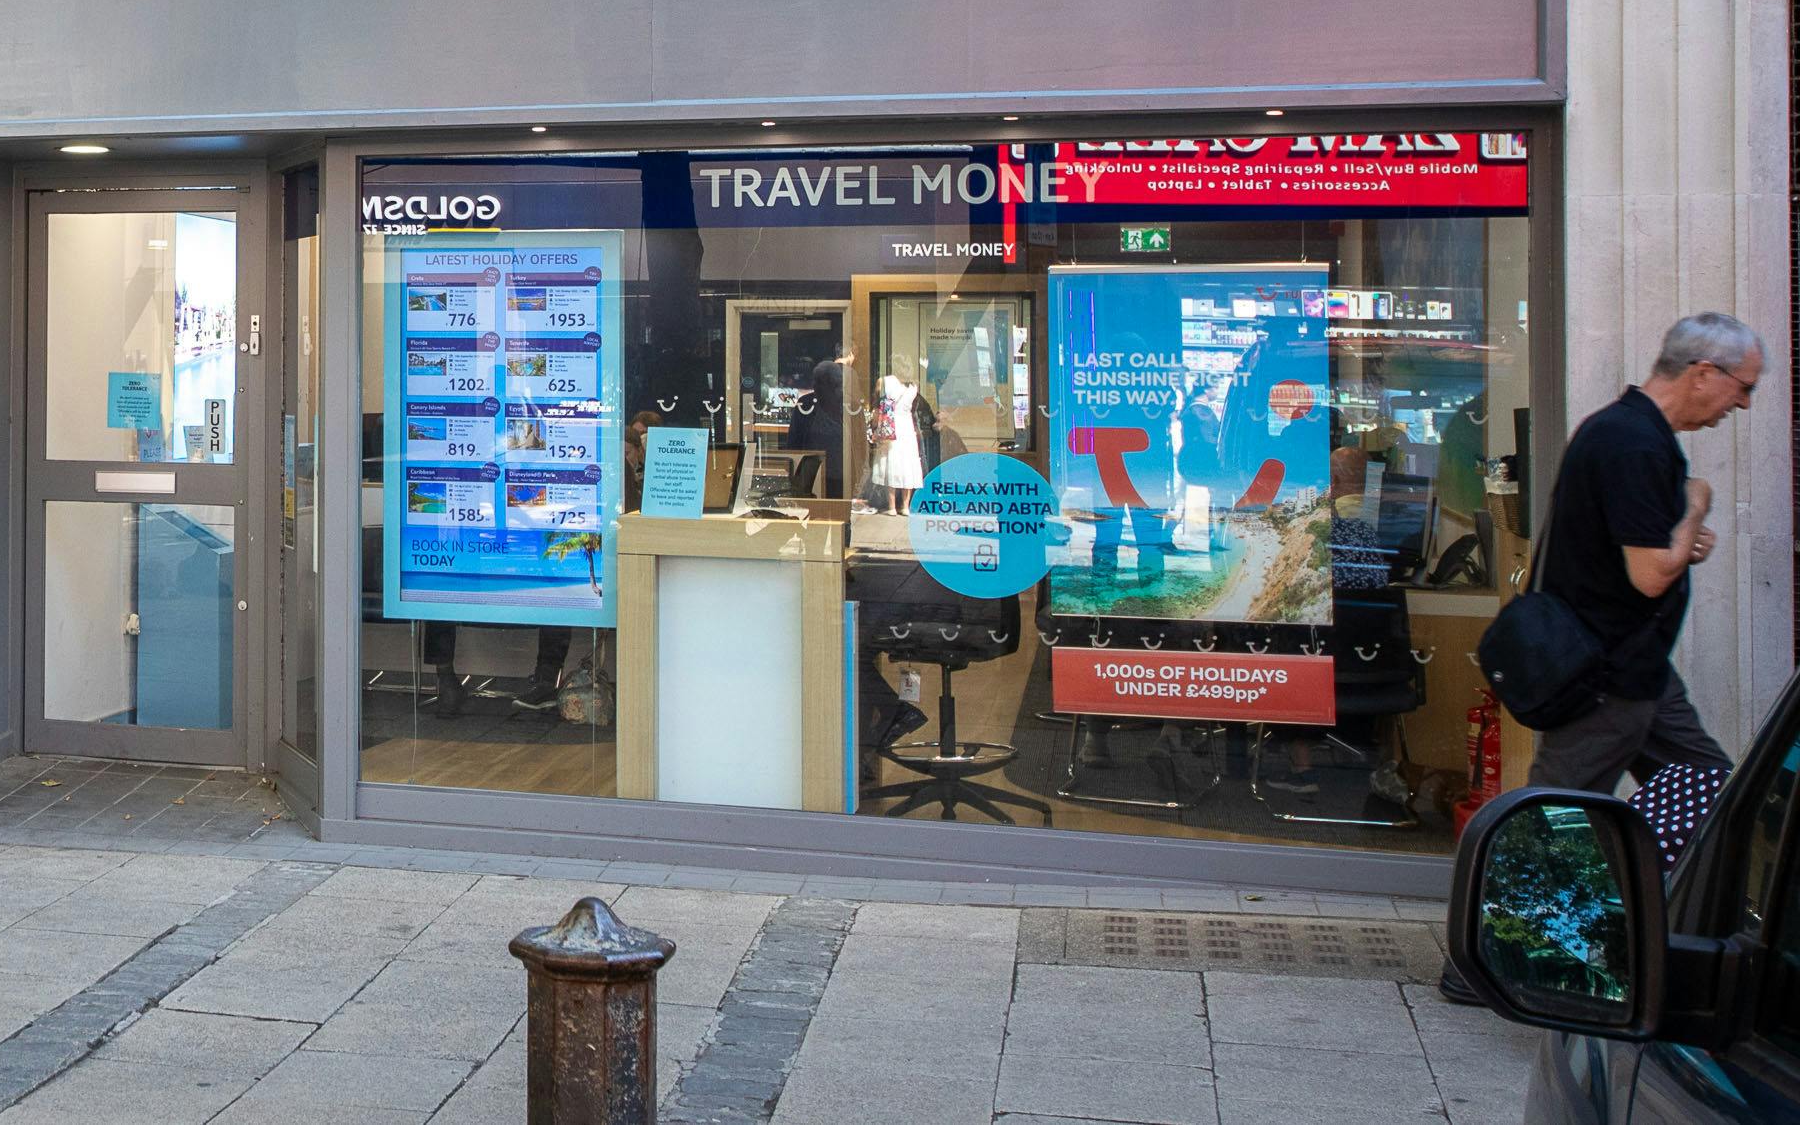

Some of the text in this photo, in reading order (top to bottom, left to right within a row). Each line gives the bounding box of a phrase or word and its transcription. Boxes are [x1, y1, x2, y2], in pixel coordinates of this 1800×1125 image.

[700, 162, 1101, 208] TRAVEL MONEY
[892, 242, 1015, 257] TRAVEL MONEY
[426, 254, 578, 265] LATEST HOLIDAY OFFERS
[448, 313, 476, 326] 776
[549, 313, 586, 326] 1953
[1073, 353, 1124, 368] LAST
[449, 378, 484, 391] 1202
[548, 378, 576, 392] 625
[1073, 371, 1183, 387] SUNSHINE
[1073, 390, 1176, 405] THIS WAY.
[210, 401, 220, 452] PUSH
[448, 443, 476, 456] 819
[549, 445, 586, 458] 1529
[658, 447, 696, 455] TOLERANCE
[931, 482, 1038, 496] RELAX WITH
[918, 501, 1053, 516] ATOL AND ABTA
[412, 539, 509, 554] BOOK IN STORE
[412, 554, 456, 567] TODAY
[1094, 664, 1289, 684] 1,000s OF HOLIDAYS
[1115, 681, 1182, 697] UNDER
